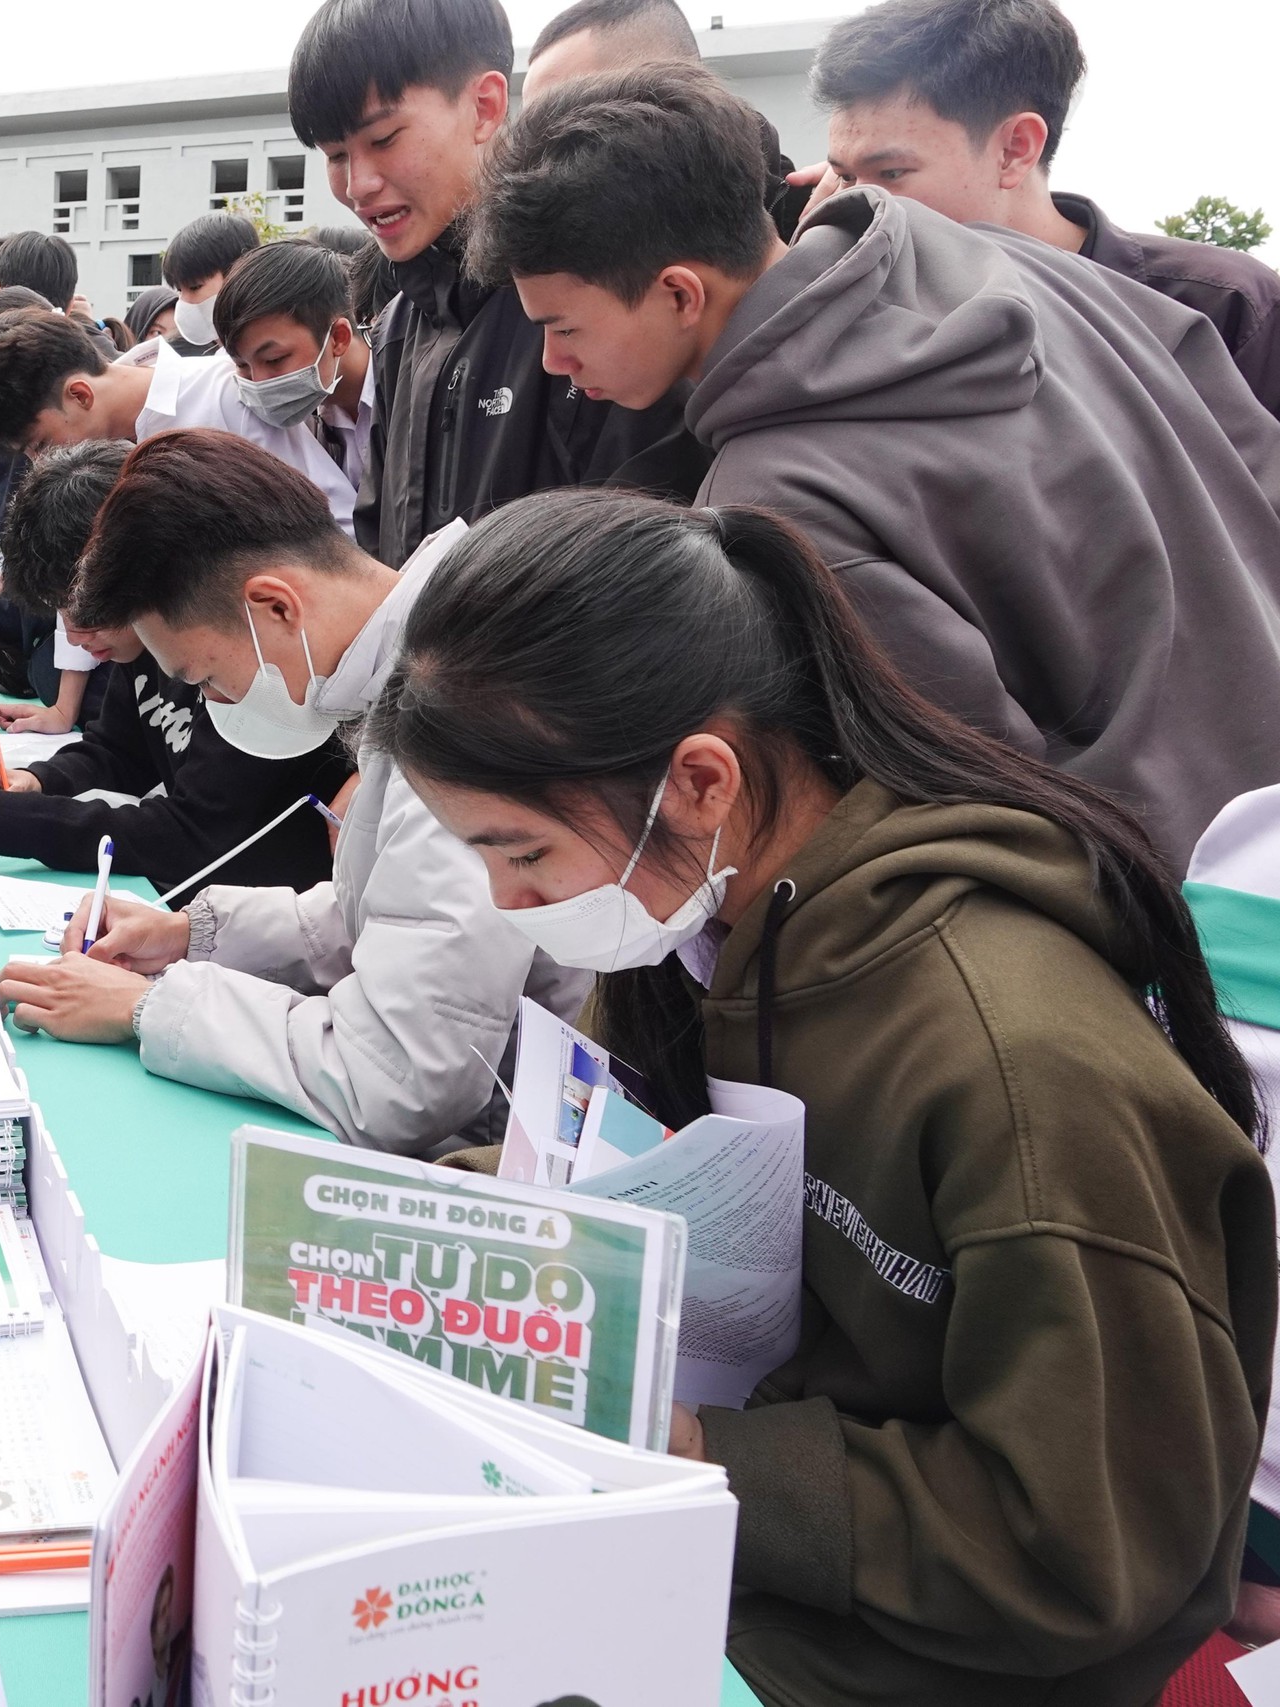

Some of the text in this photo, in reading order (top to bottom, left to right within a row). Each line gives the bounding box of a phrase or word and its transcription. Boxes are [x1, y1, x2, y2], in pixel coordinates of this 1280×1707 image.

[478, 397, 503, 409] NORTH
[494, 387, 503, 397] THE
[486, 406, 503, 416] FACE
[620, 1180, 659, 1196] MBTI
[317, 1184, 558, 1240] CHỌN ĐH ĐÔNG Á
[289, 1234, 588, 1314] CHỌN TỰ DO
[288, 1267, 426, 1326] THEO
[442, 1298, 584, 1359] ĐUỔI
[398, 1570, 476, 1598] ĐẠI HỌC
[397, 1586, 485, 1620] ĐÔNG Á
[341, 1665, 479, 1707] HƯỚNG
